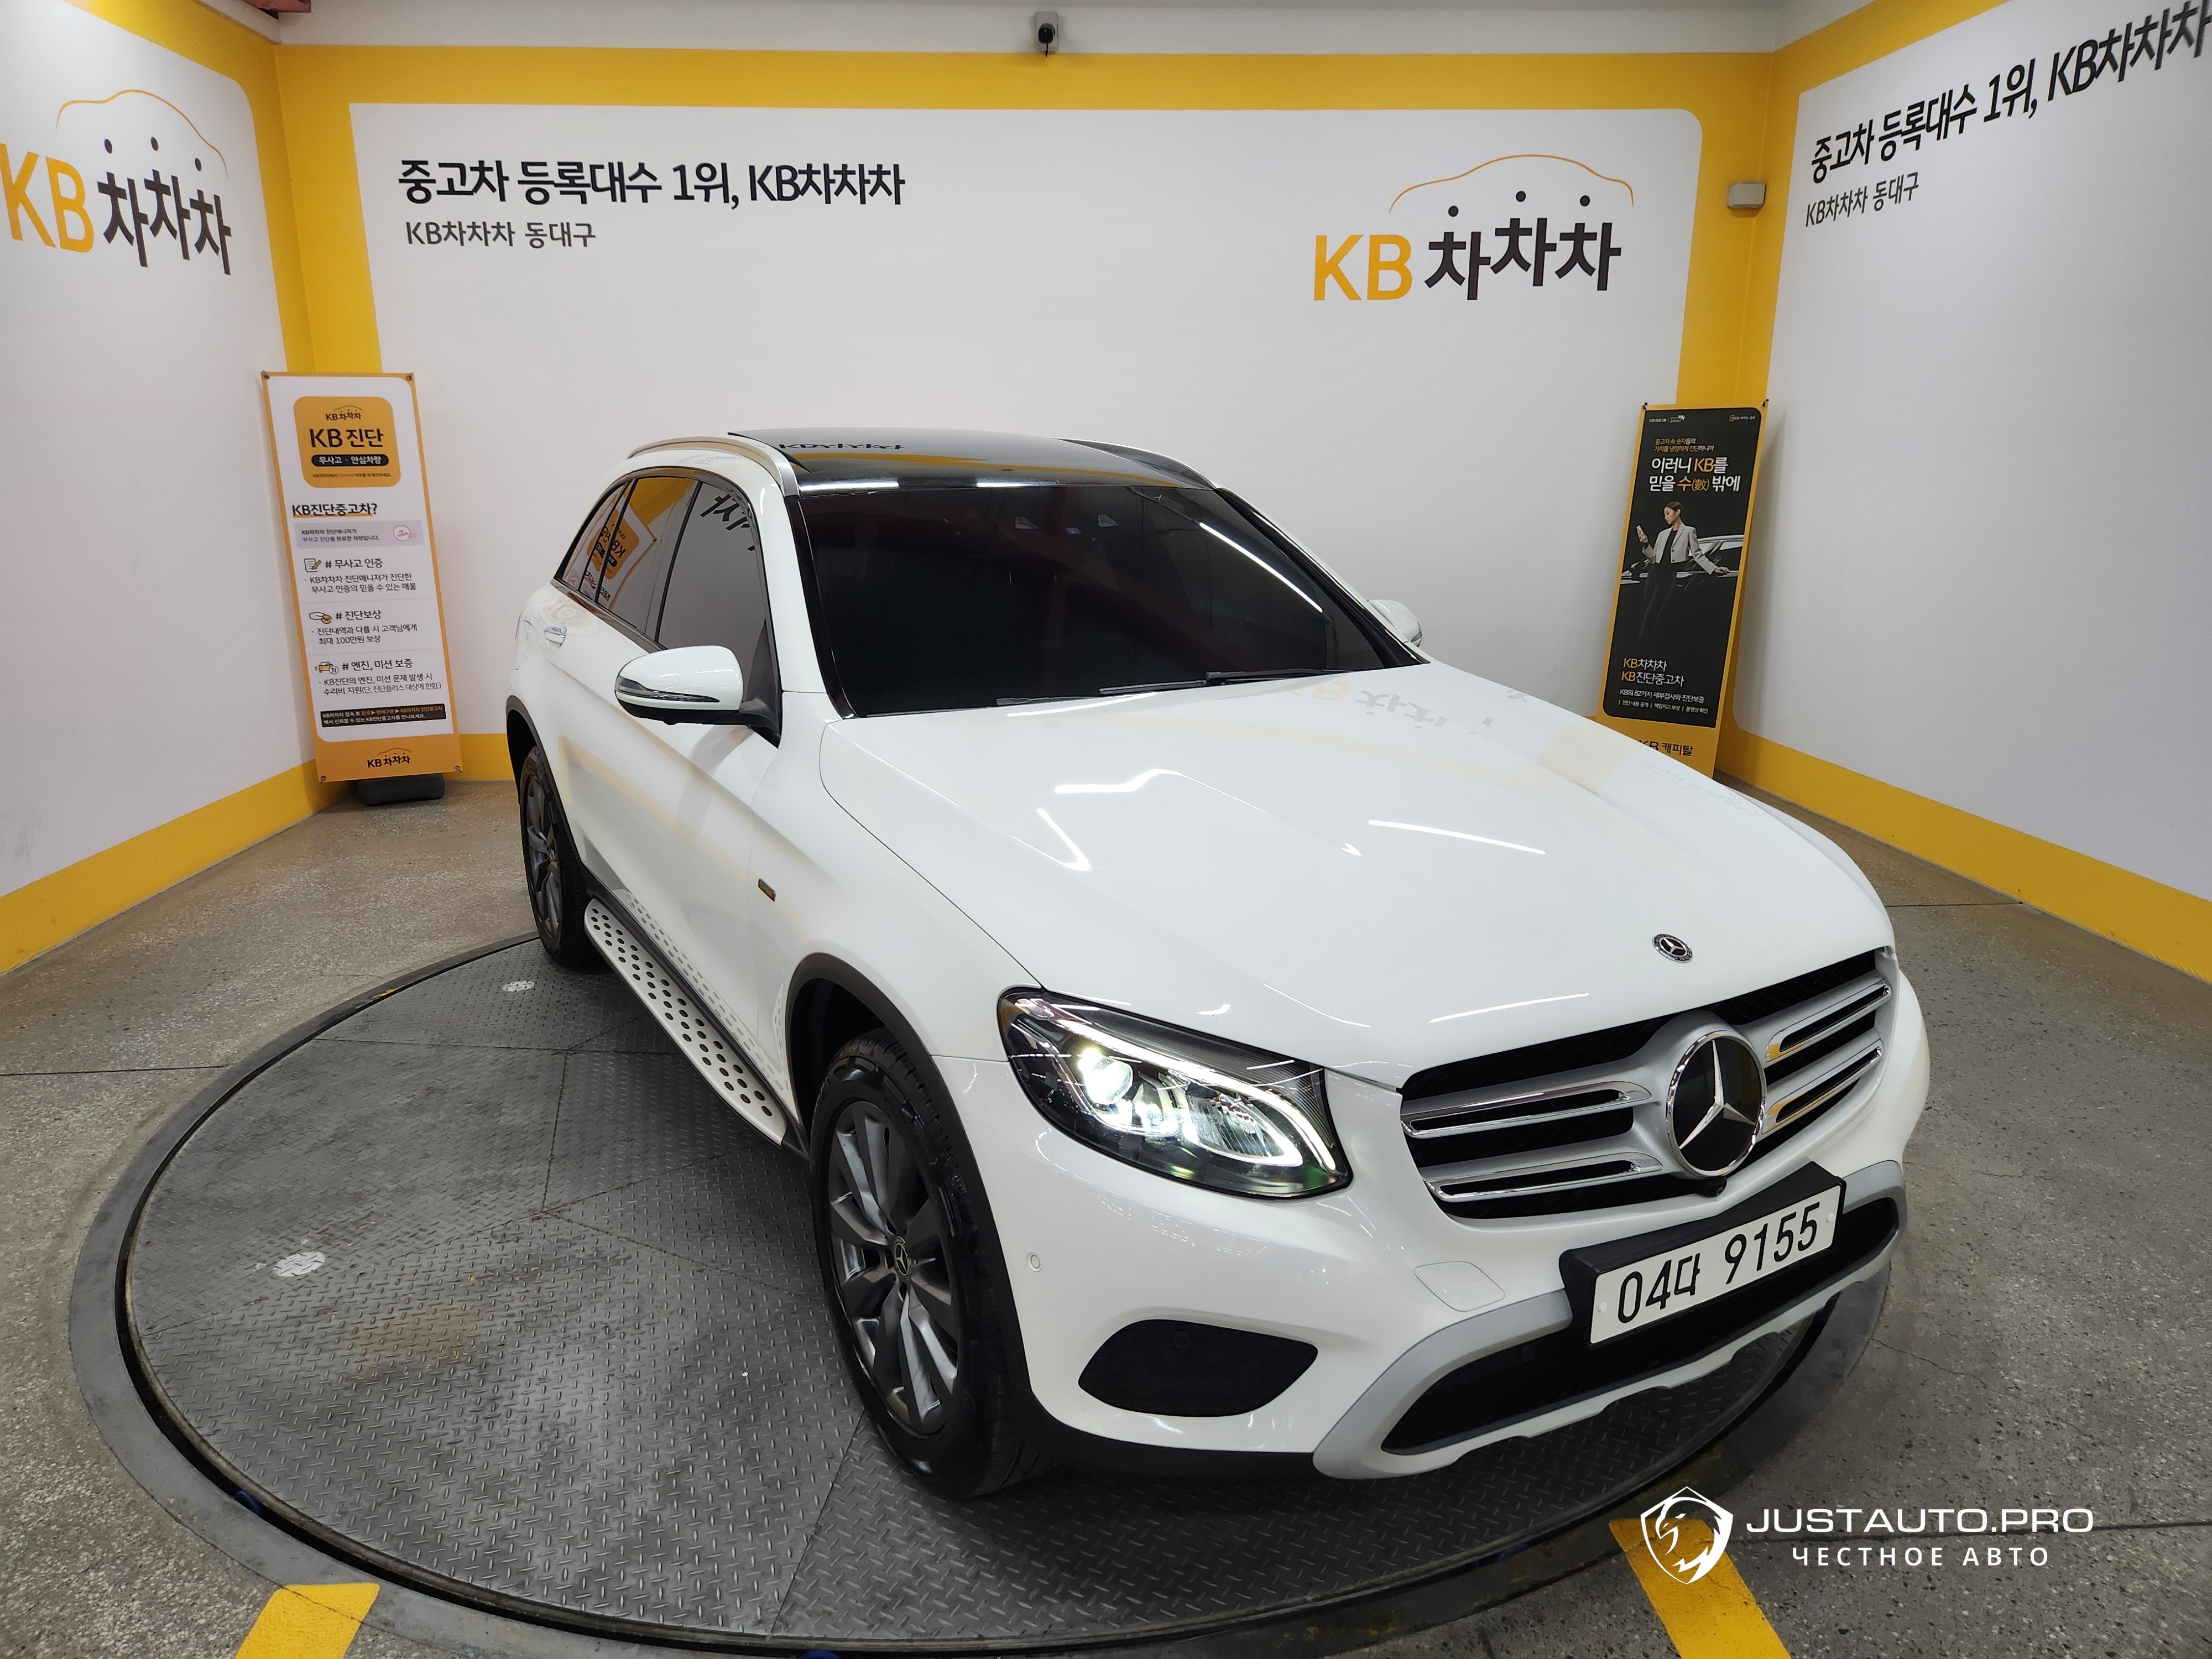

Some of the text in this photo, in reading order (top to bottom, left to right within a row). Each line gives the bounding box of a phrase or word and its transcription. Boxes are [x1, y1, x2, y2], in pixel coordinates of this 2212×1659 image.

[1811, 0, 2212, 183] 중고차 등록대수 1위, KB차차차
[398, 159, 905, 210] 중고차 등록대수 1위, KB차차차
[0, 137, 232, 275] KB 차차차
[1805, 171, 1919, 227] KB차차차 동대구
[405, 221, 596, 248] KB차차차 동대구
[1313, 191, 1621, 300] KB 차차차
[309, 429, 383, 447] KB 진단
[319, 456, 382, 465] 무사고 안심차량
[1651, 457, 1728, 474] 이러니 KB를
[1649, 475, 1676, 492] 믿을
[1712, 476, 1741, 492] 밖에
[292, 503, 378, 516] KB진단중고차?
[335, 559, 363, 568] 무사고
[364, 558, 383, 568] 인증
[310, 573, 412, 584] KB차차차 진단매니저가 진단한
[311, 586, 334, 594] 무사고
[385, 583, 400, 591] 있는
[345, 610, 382, 620] 진단보상
[317, 627, 353, 635] 진단내역과
[382, 624, 418, 632] 고객님에게
[336, 636, 364, 644] 100만원
[351, 661, 373, 671] 엔진,
[374, 660, 393, 670] 미션
[395, 659, 413, 668] 보증
[1623, 657, 1667, 672] KB차차차
[324, 677, 356, 686] KB진단의
[393, 674, 407, 682] 문제
[409, 674, 423, 682] 발생
[1621, 671, 1685, 687] KB진단중고차
[324, 687, 345, 696] 수리비
[1662, 743, 1693, 757] 캐피탈
[367, 752, 411, 768] KB 차차차
[1618, 1202, 1820, 1323] 04다 9155
